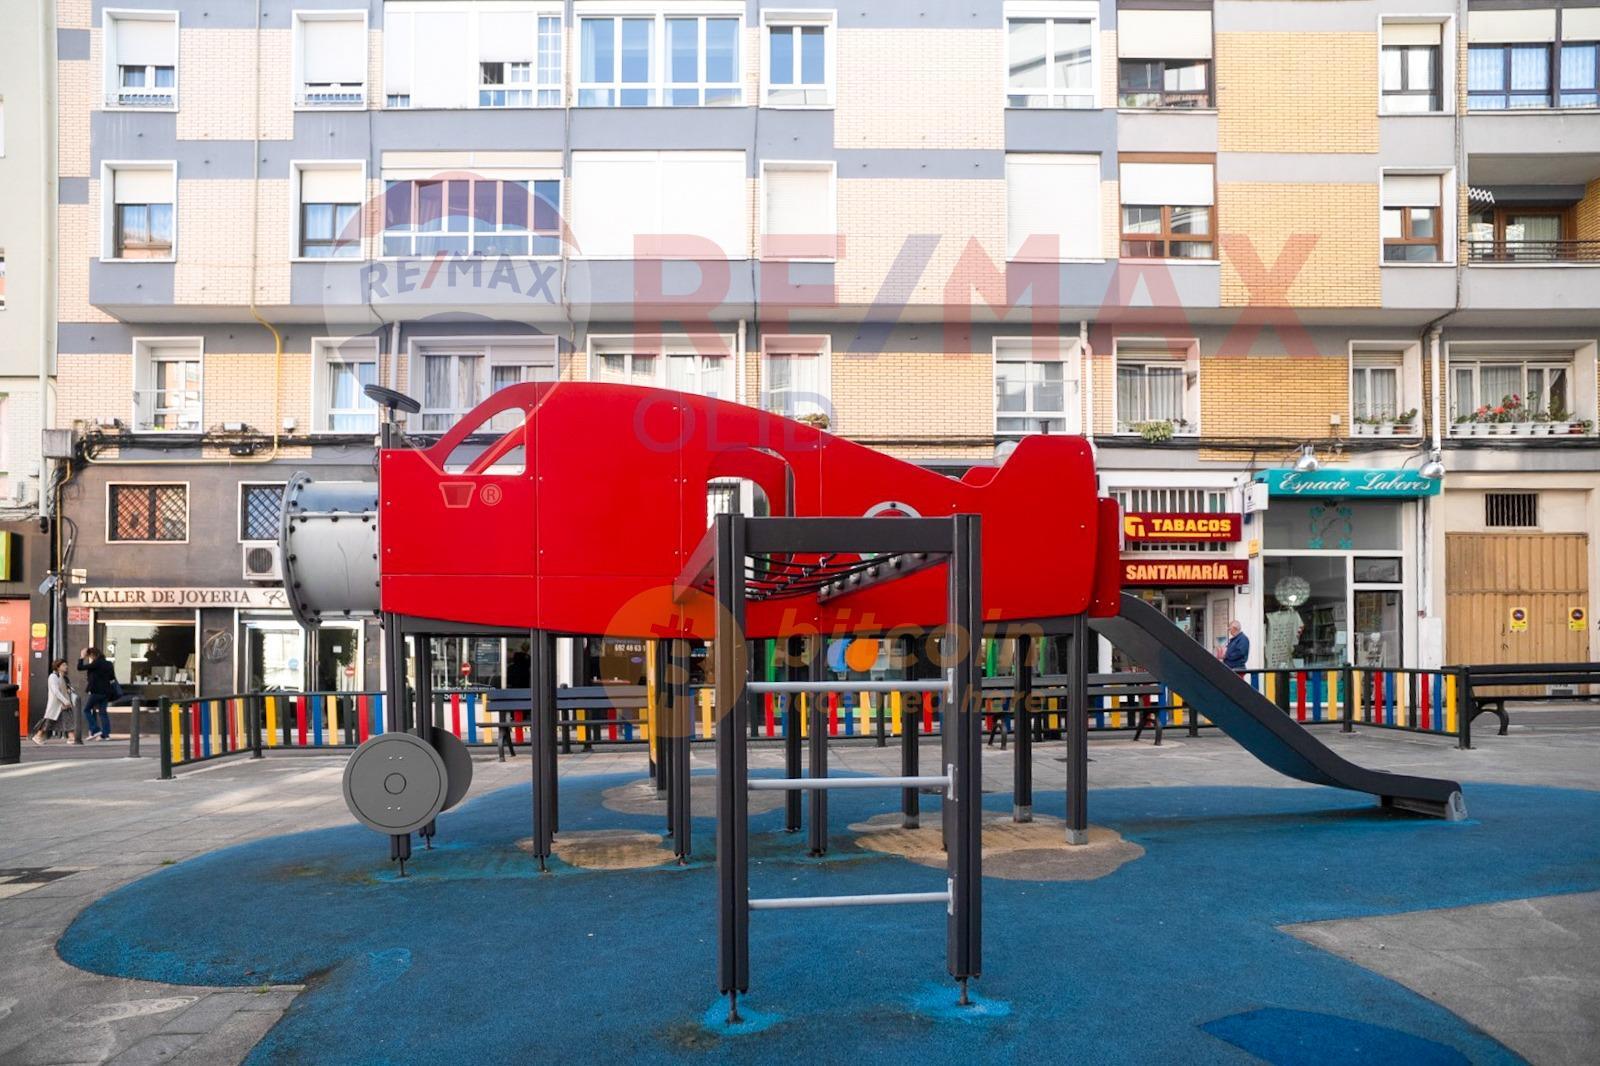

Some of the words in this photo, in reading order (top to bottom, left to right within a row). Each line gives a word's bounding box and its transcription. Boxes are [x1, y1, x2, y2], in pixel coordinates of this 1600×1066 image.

[1279, 472, 1349, 493] Espacio
[1355, 472, 1432, 491] Labores
[1151, 518, 1232, 532] TABACOS
[1125, 562, 1229, 580] SANTAMARÍA
[81, 590, 146, 604] TALLER
[152, 590, 175, 603] DE
[178, 590, 251, 605] JOYERIA
